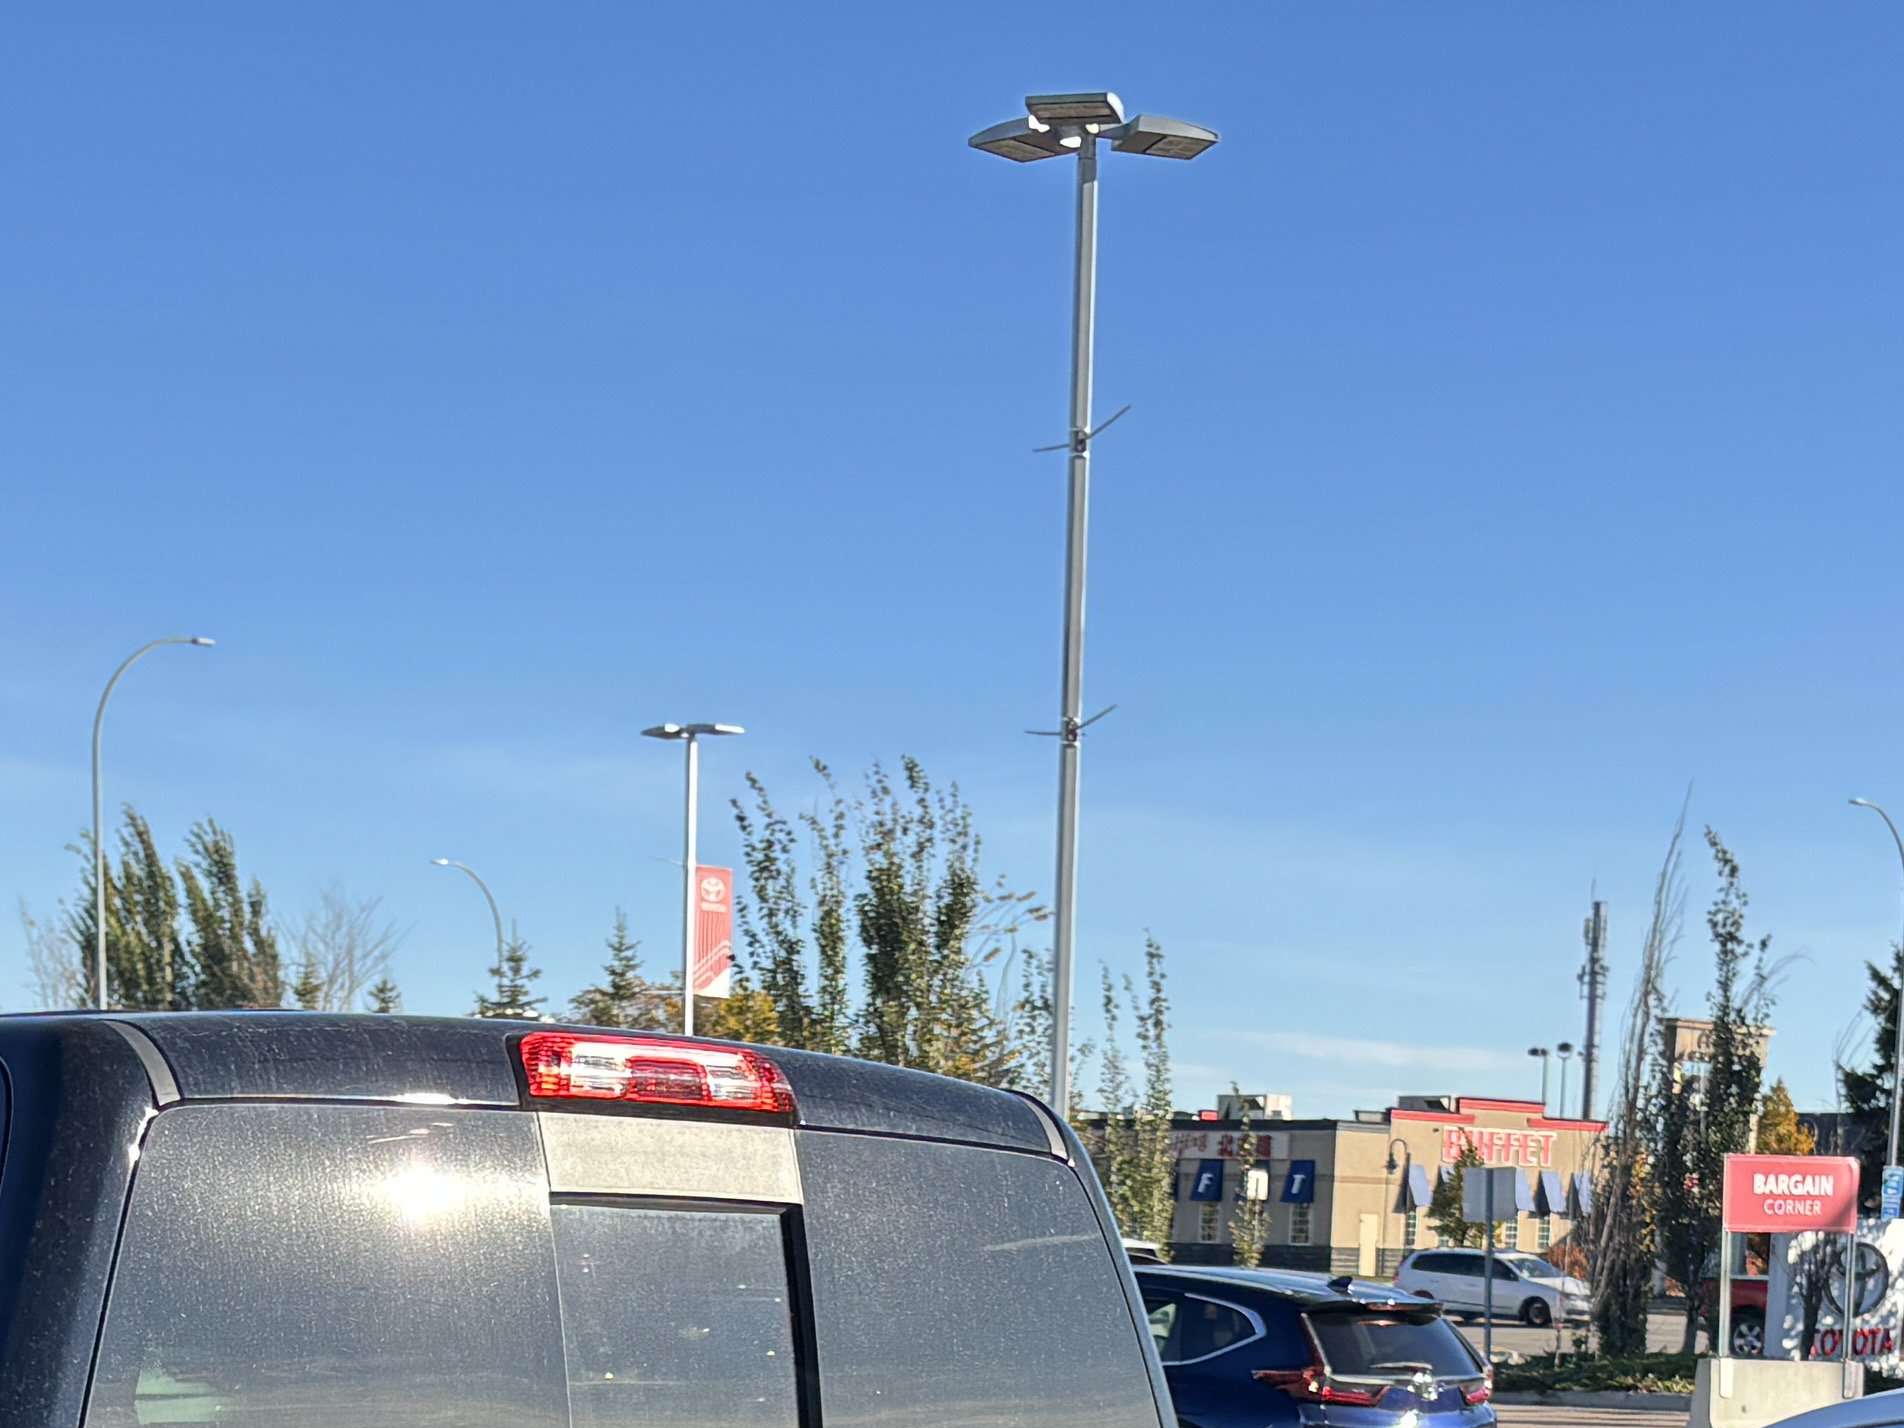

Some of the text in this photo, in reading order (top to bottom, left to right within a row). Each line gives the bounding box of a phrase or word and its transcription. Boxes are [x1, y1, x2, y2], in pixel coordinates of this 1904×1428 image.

[1443, 1126, 1557, 1167] BUFFET
[1753, 1173, 1834, 1197] BARGAIN
[1763, 1199, 1822, 1216] CORNER
